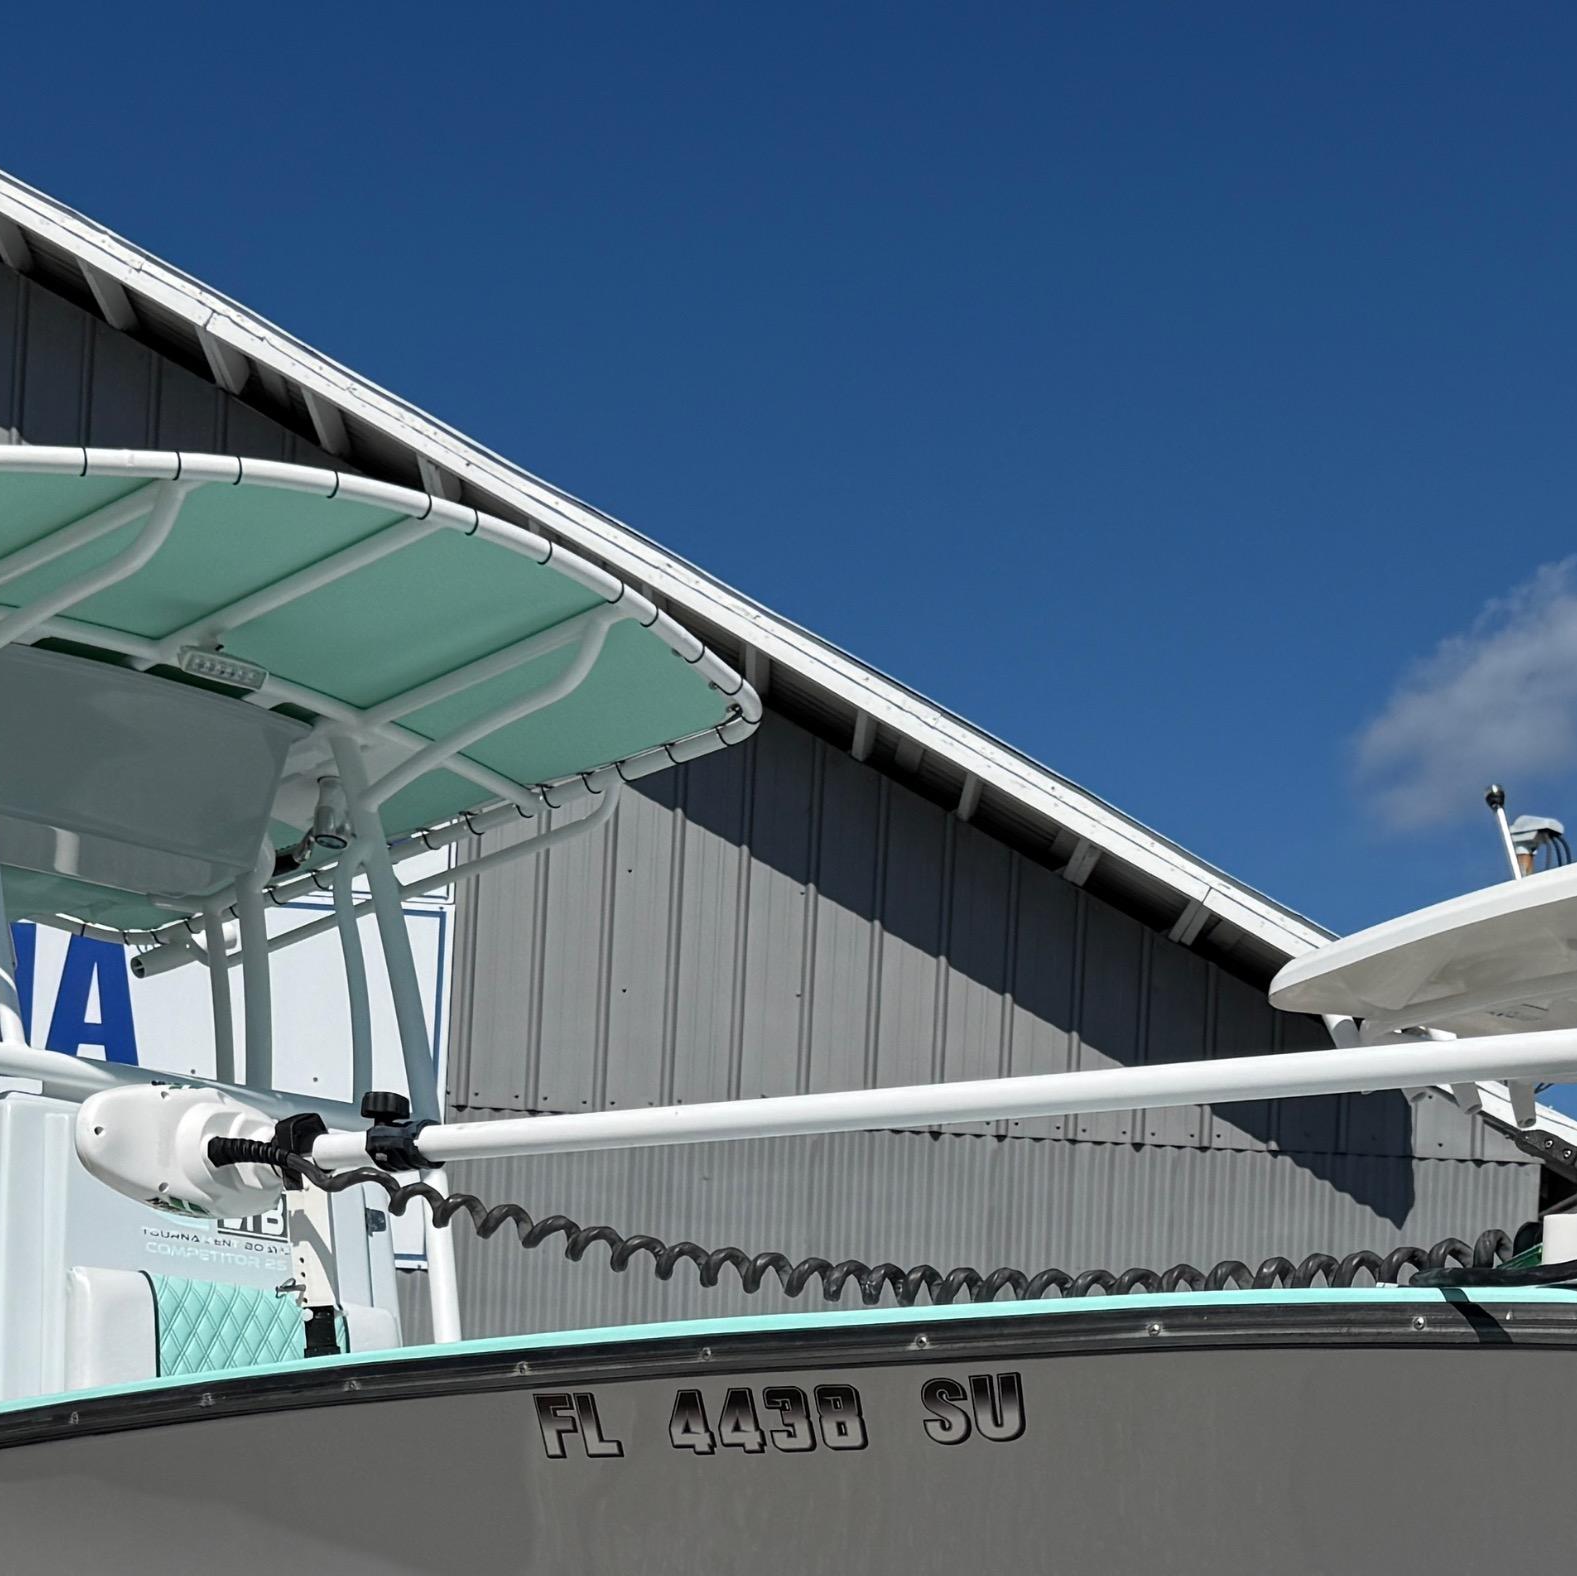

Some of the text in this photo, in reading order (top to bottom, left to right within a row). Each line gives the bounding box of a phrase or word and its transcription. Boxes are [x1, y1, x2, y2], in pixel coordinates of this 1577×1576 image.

[143, 1228, 291, 1256] TOURNAENT BOA
[145, 1241, 261, 1267] COMPETITOR
[532, 1371, 1026, 1459] FL 4438 SU
